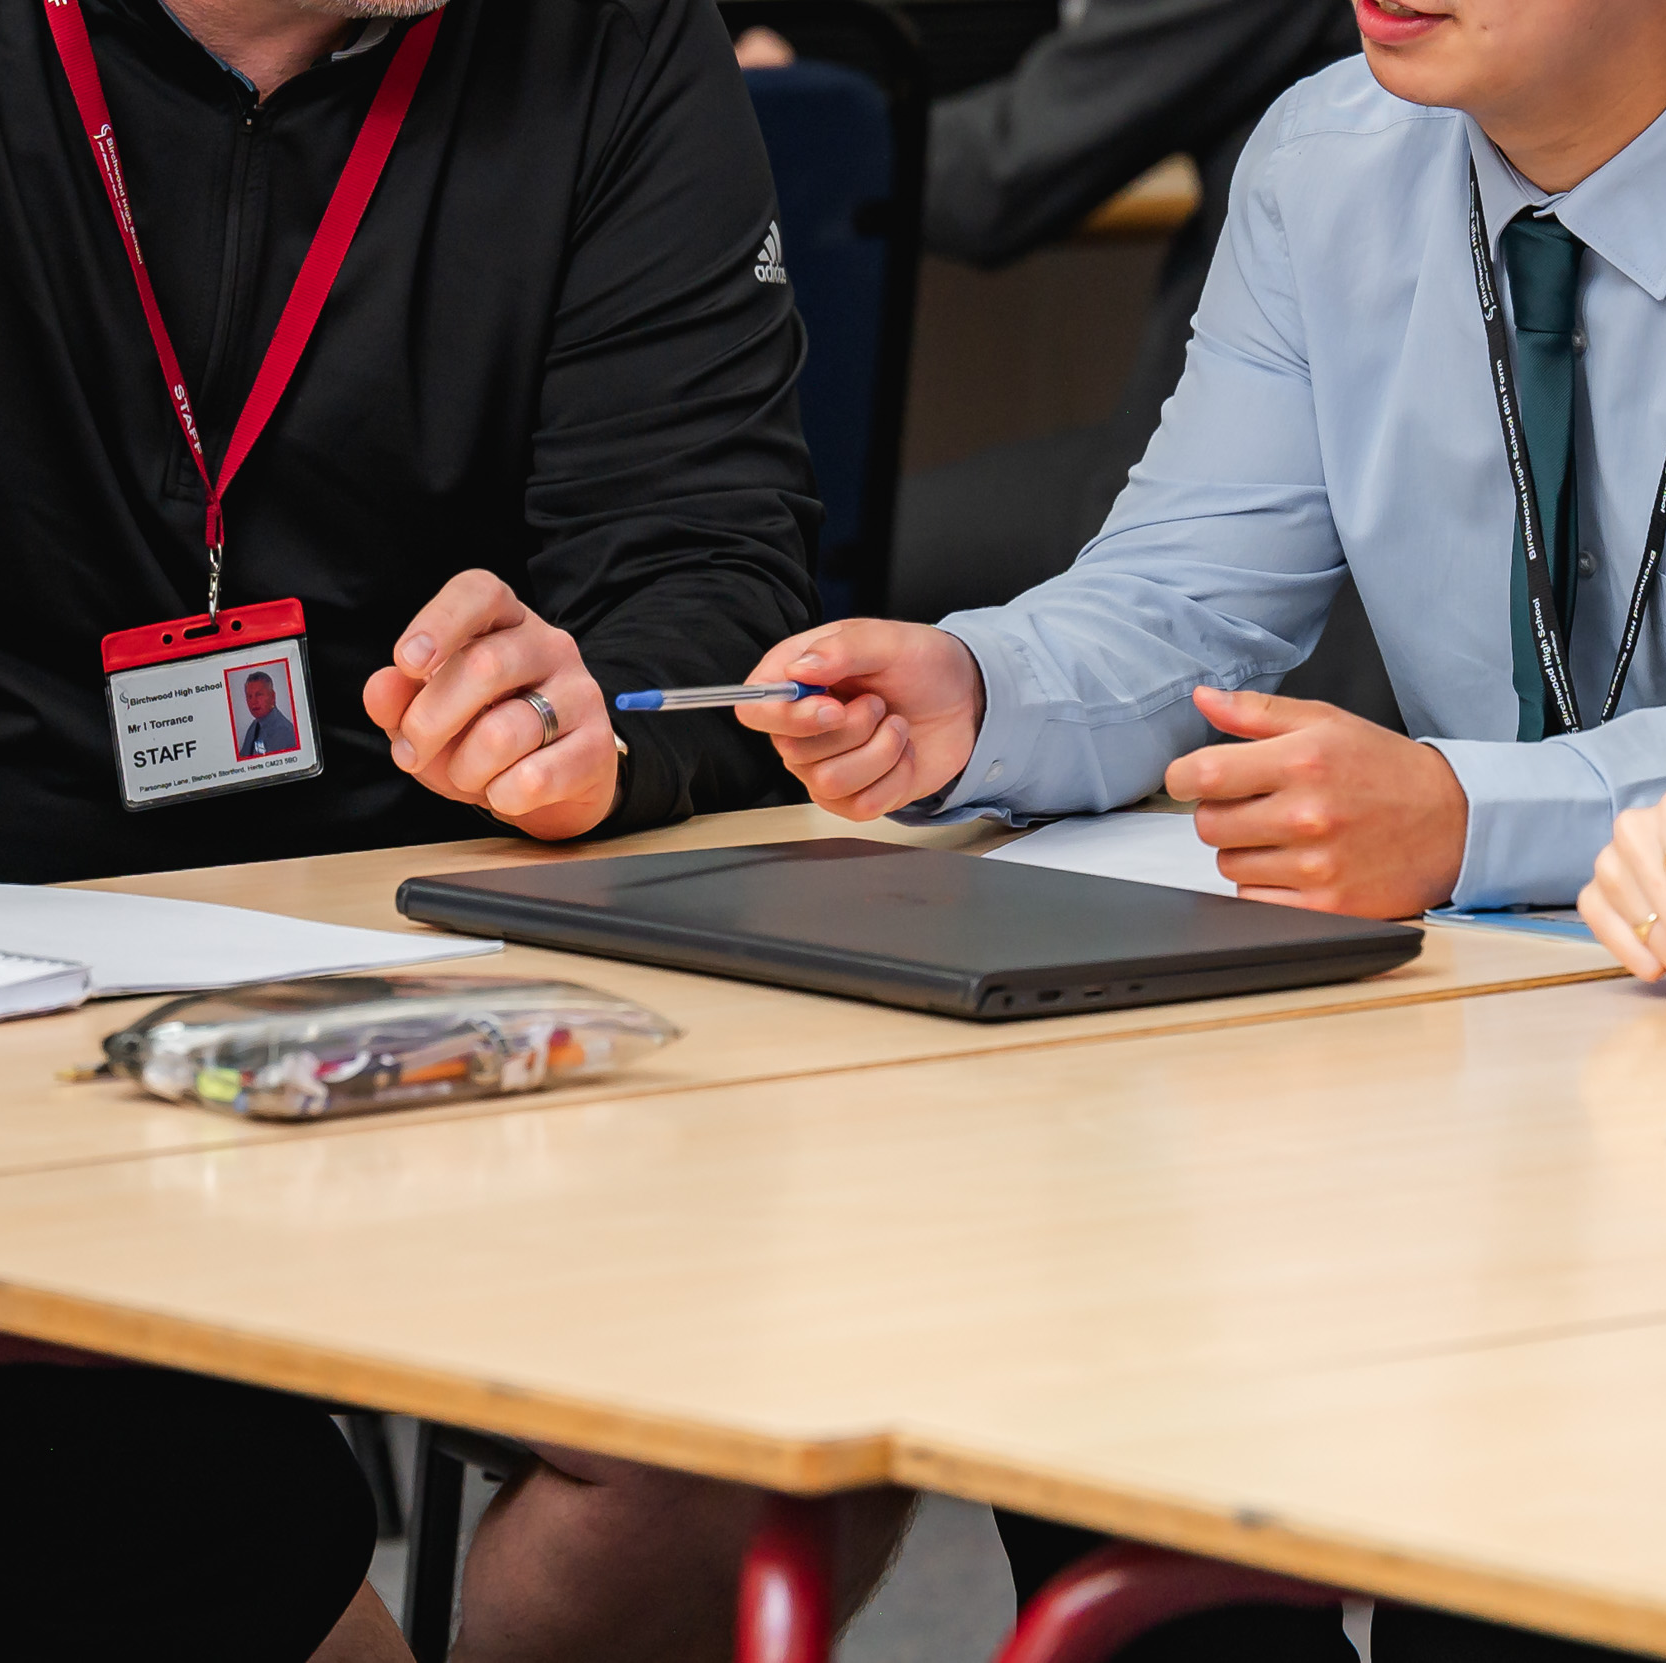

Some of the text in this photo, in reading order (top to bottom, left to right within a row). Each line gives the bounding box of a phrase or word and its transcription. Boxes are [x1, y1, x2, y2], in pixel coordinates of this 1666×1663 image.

[106, 137, 125, 197] Birchwood
[122, 198, 132, 224] High
[1474, 248, 1490, 308] Birchwood
[174, 384, 203, 455] STAFF
[1496, 359, 1537, 561] Birchwood High School 6th Form
[1633, 550, 1657, 618] Birchwood
[130, 681, 223, 706] Birchwood High School
[1532, 598, 1572, 726] Birchwood High School
[127, 724, 141, 734] Mr
[149, 715, 194, 729] Torrance
[133, 740, 197, 768] STAFF
[192, 772, 217, 783] Bishop's
